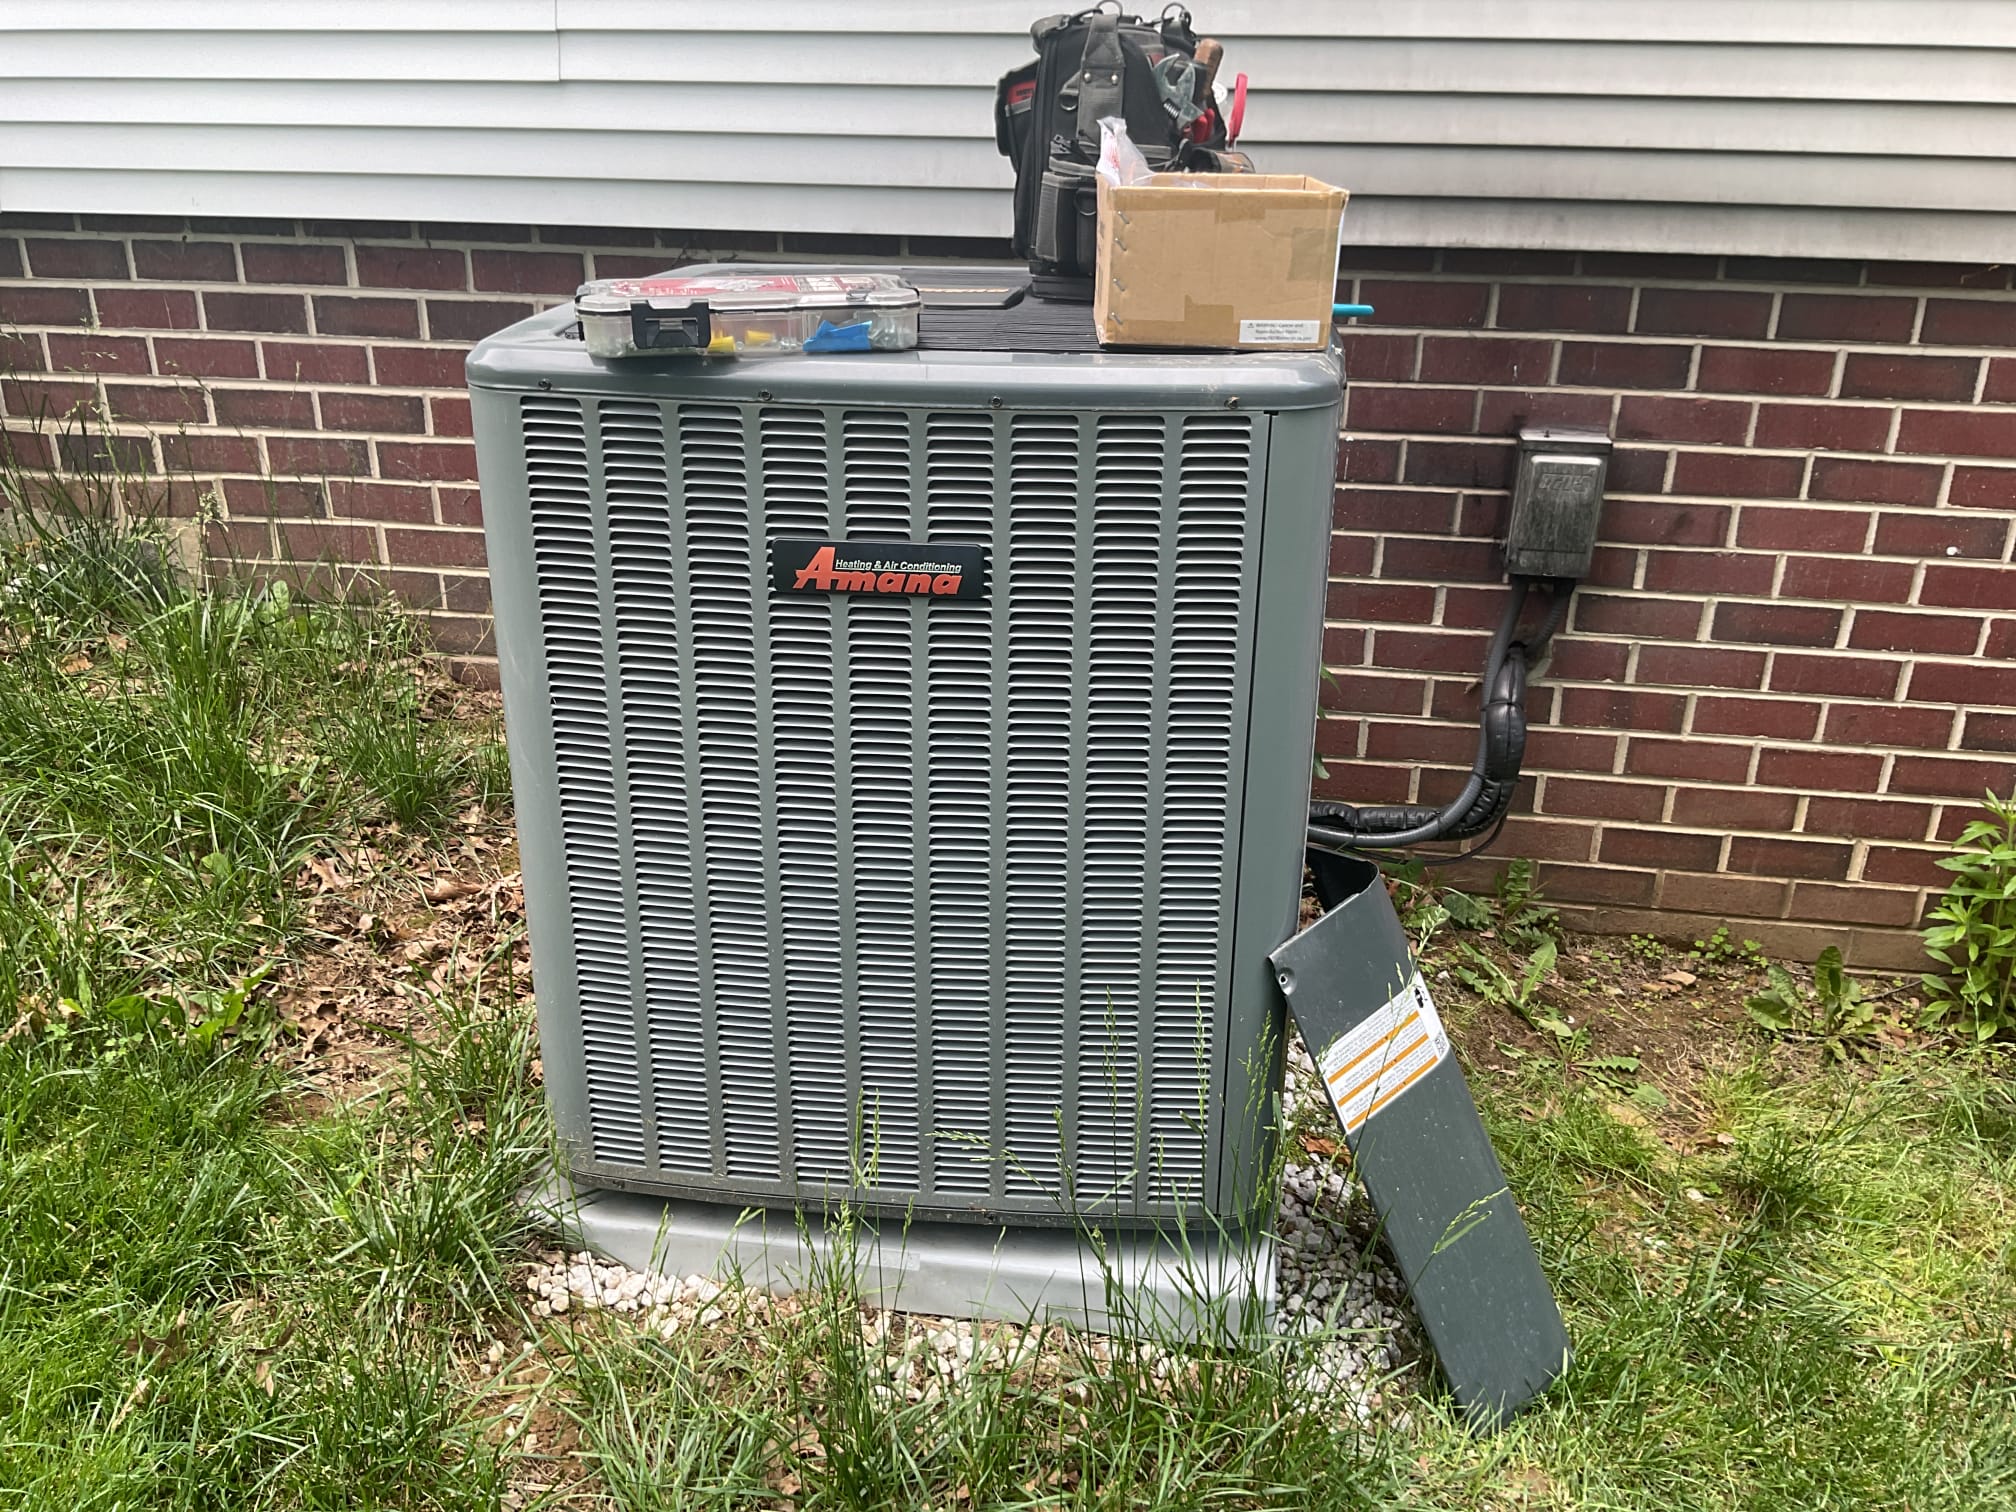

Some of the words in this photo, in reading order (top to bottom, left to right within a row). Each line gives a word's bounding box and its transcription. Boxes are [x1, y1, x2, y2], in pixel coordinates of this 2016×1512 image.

[793, 546, 963, 595] Amana
[835, 559, 873, 570] Heating
[875, 560, 882, 570] &
[883, 561, 897, 571] Air
[900, 561, 962, 573] Conditioning
